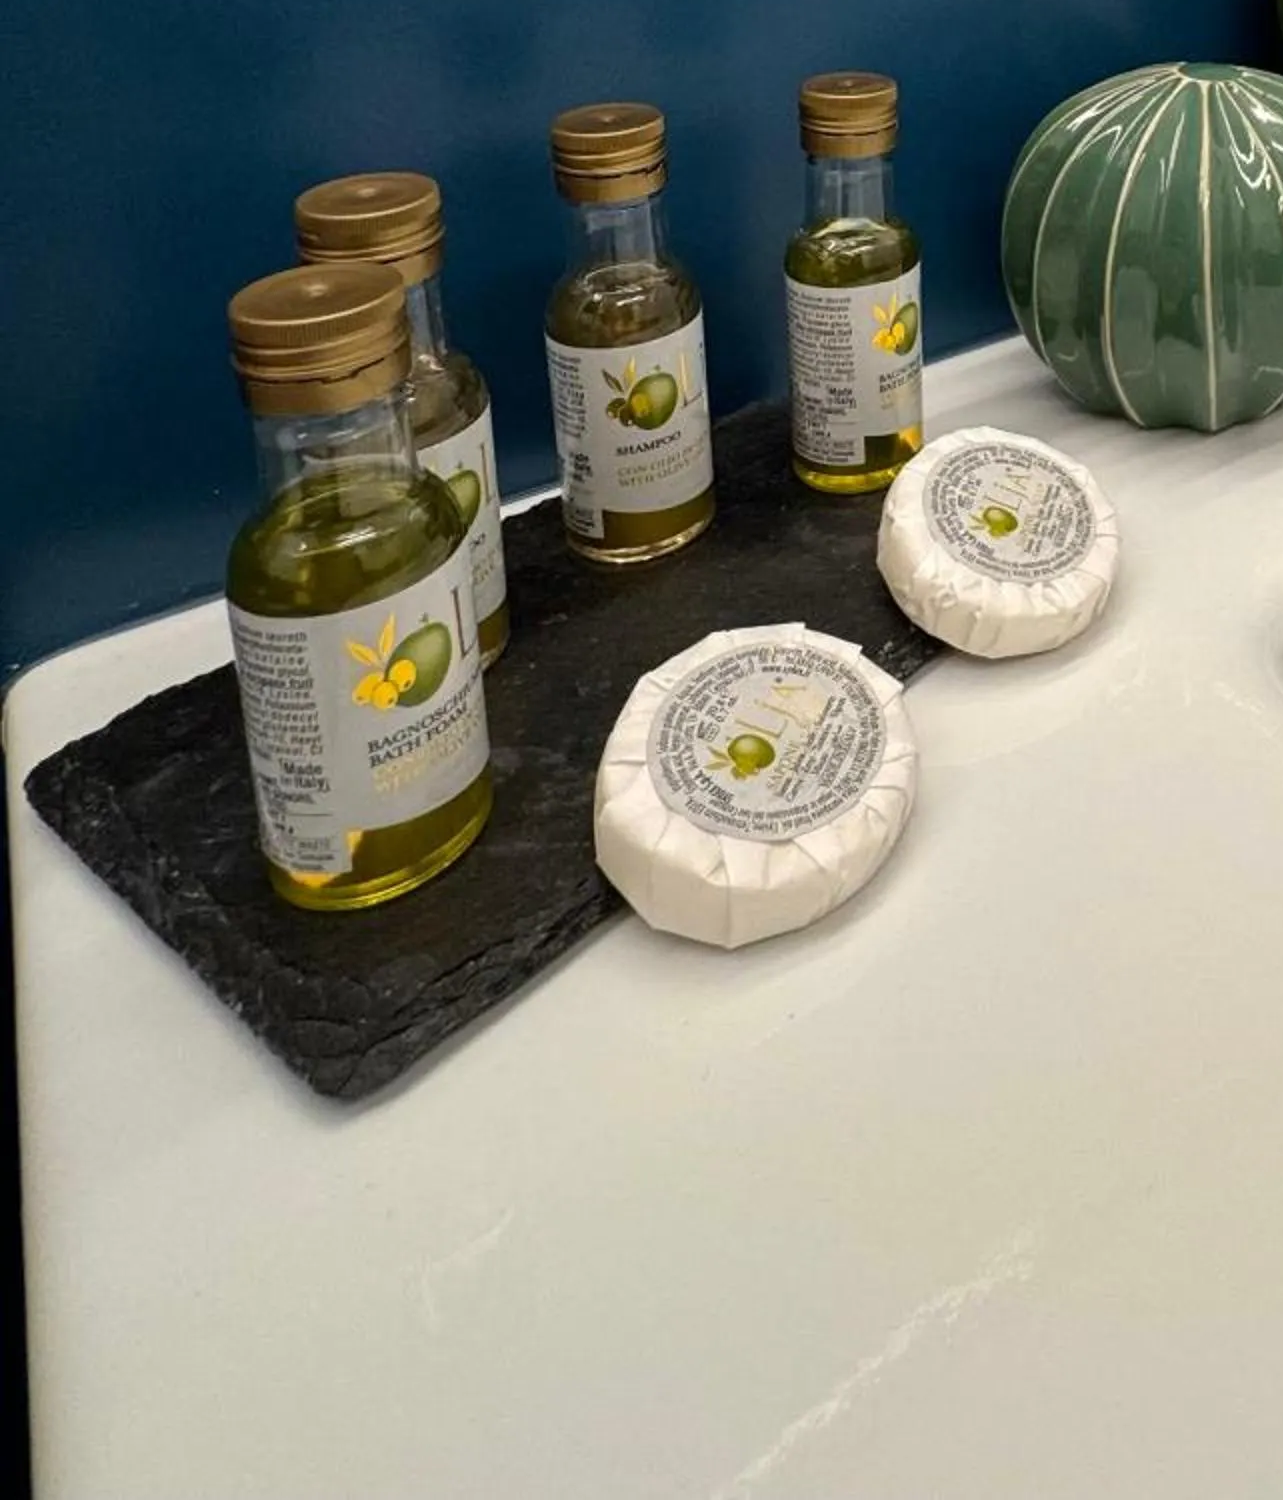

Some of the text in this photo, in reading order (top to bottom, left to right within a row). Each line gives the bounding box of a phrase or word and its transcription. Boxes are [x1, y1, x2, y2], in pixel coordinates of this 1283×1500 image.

[615, 430, 682, 457] SHAMPOO
[368, 733, 421, 769] BATH
[282, 759, 323, 775] Made
